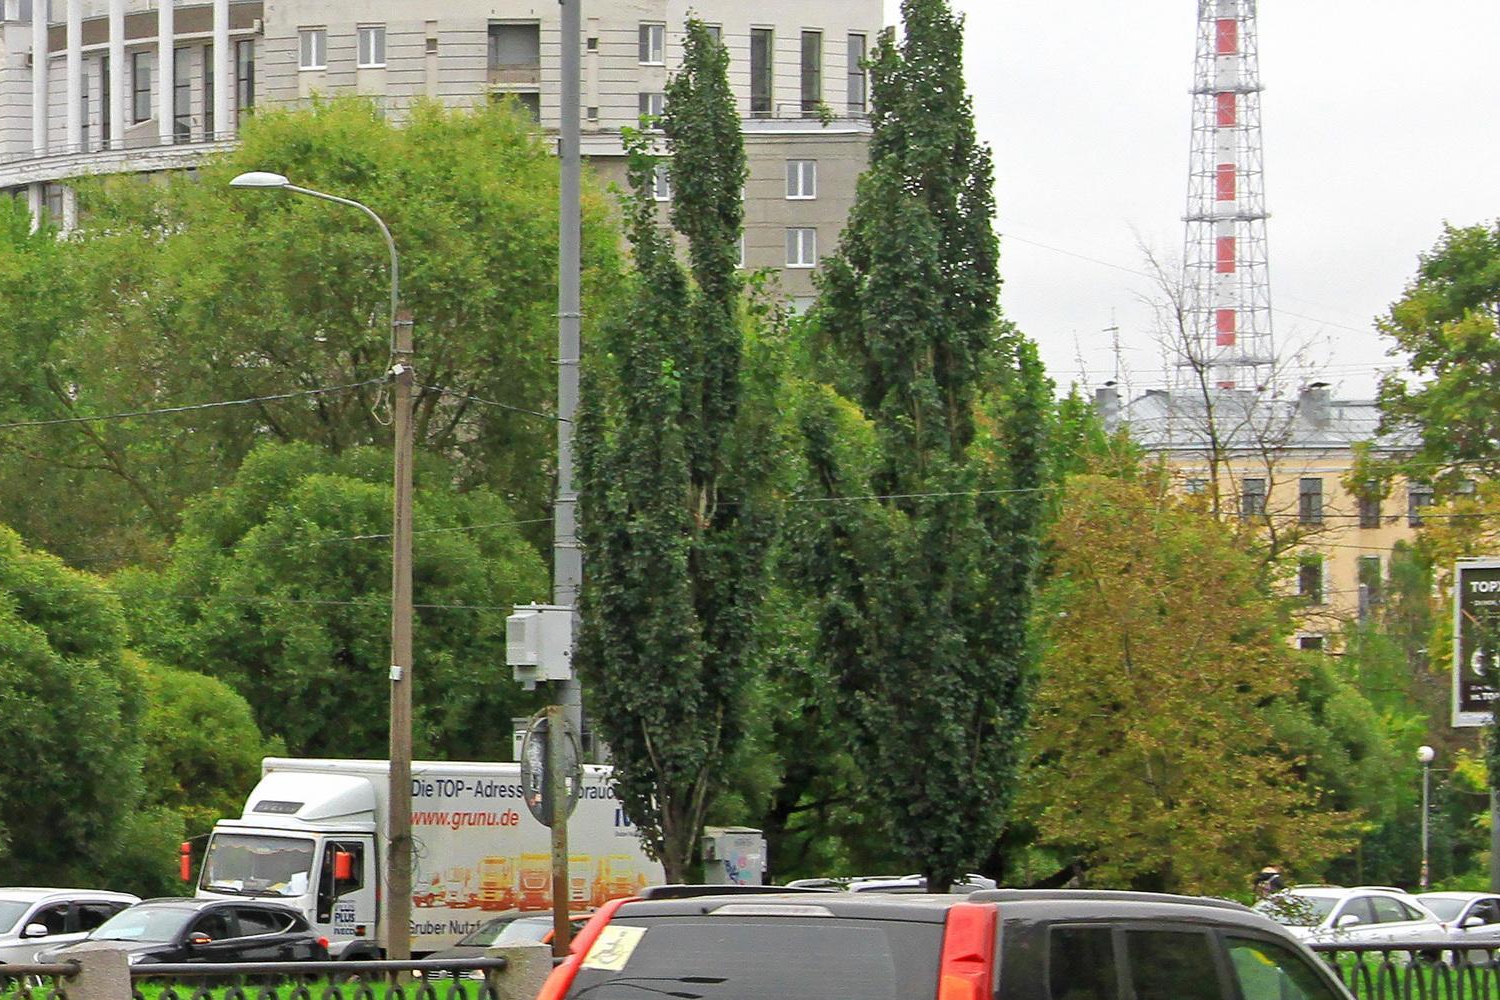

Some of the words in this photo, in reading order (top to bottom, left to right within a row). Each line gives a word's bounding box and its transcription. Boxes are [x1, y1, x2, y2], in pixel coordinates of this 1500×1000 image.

[411, 779, 434, 797] Die
[436, 779, 523, 798] TOP-Adress
[410, 809, 519, 830] www.grunu.de
